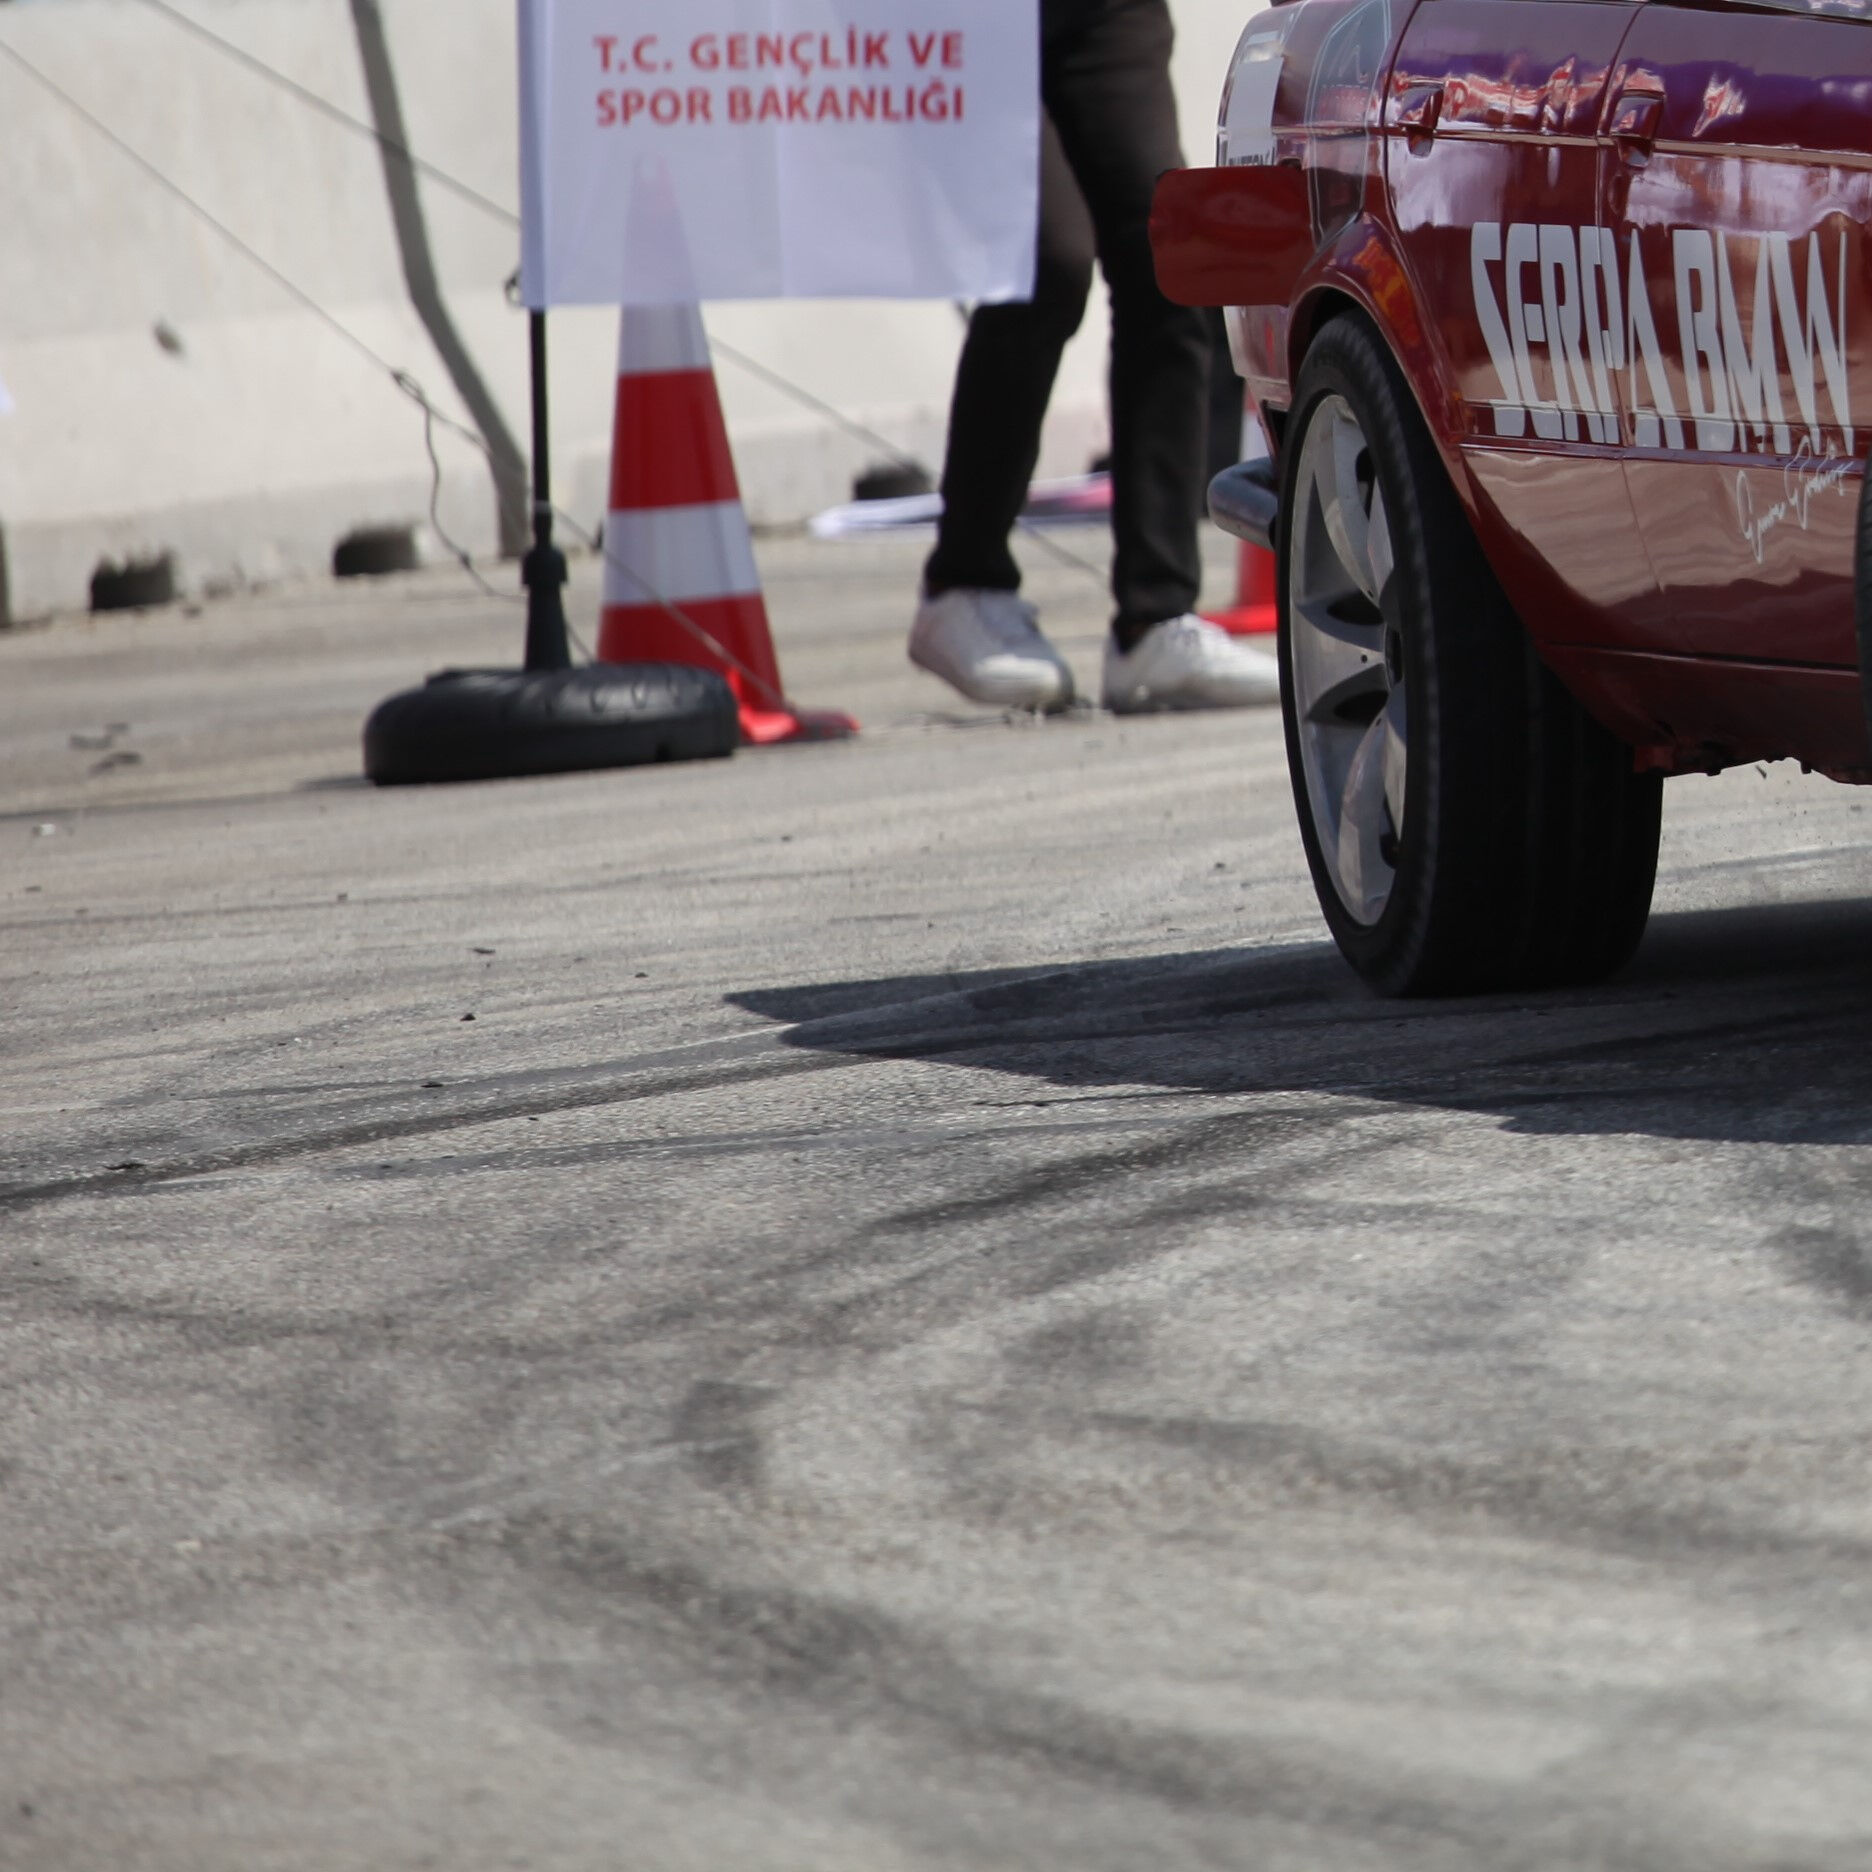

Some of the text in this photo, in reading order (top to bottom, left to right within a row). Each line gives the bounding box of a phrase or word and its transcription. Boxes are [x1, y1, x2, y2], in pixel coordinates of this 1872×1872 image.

[593, 23, 964, 79] T.C. GENÇLİK VE
[596, 76, 964, 127] SPOR BAKANLIĞI
[1470, 222, 1854, 458] SERPA BMW
